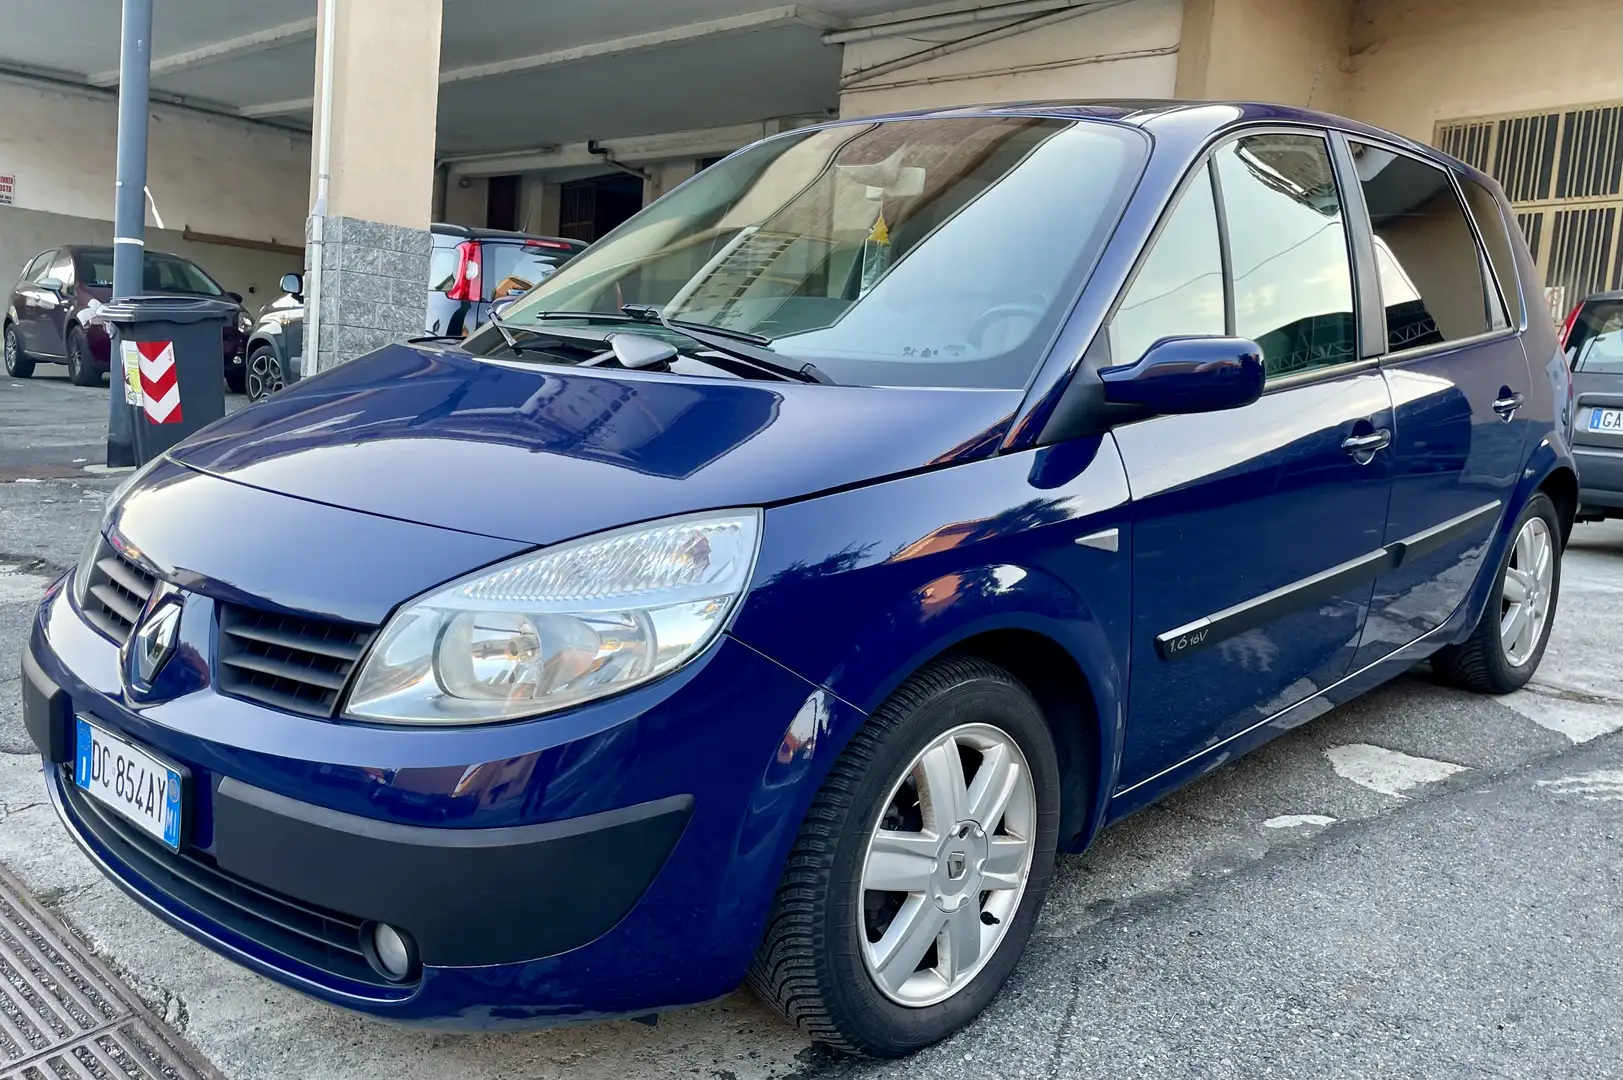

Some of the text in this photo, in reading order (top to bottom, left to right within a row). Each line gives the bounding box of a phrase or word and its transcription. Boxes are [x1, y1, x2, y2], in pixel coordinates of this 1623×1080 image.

[1603, 411, 1621, 428] GA
[1170, 629, 1209, 653] 1.6 16V
[91, 739, 111, 788] DC
[115, 755, 167, 823] 854AY
[165, 806, 177, 837] MI
